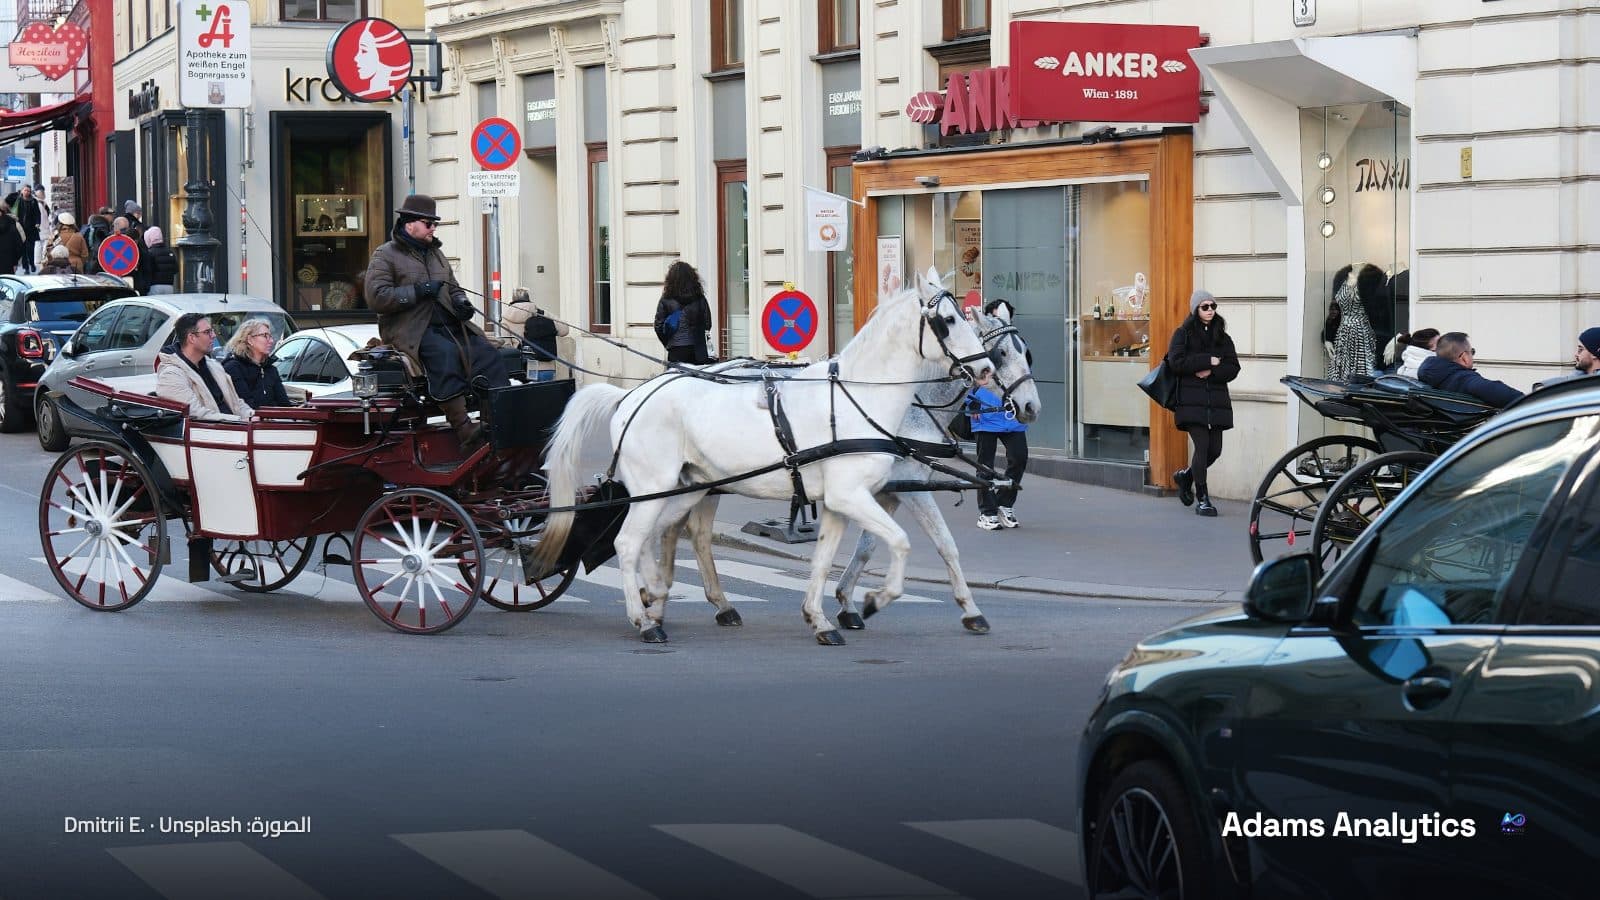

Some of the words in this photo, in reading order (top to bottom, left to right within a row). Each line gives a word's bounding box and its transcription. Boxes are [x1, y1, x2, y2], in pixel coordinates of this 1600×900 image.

[186, 50, 227, 59] Apotheke
[221, 61, 245, 70] Engel
[1062, 51, 1158, 78] ANKER
[188, 70, 239, 79] Bognergasse
[1083, 88, 1109, 99] Wien
[1115, 89, 1138, 99] 1891
